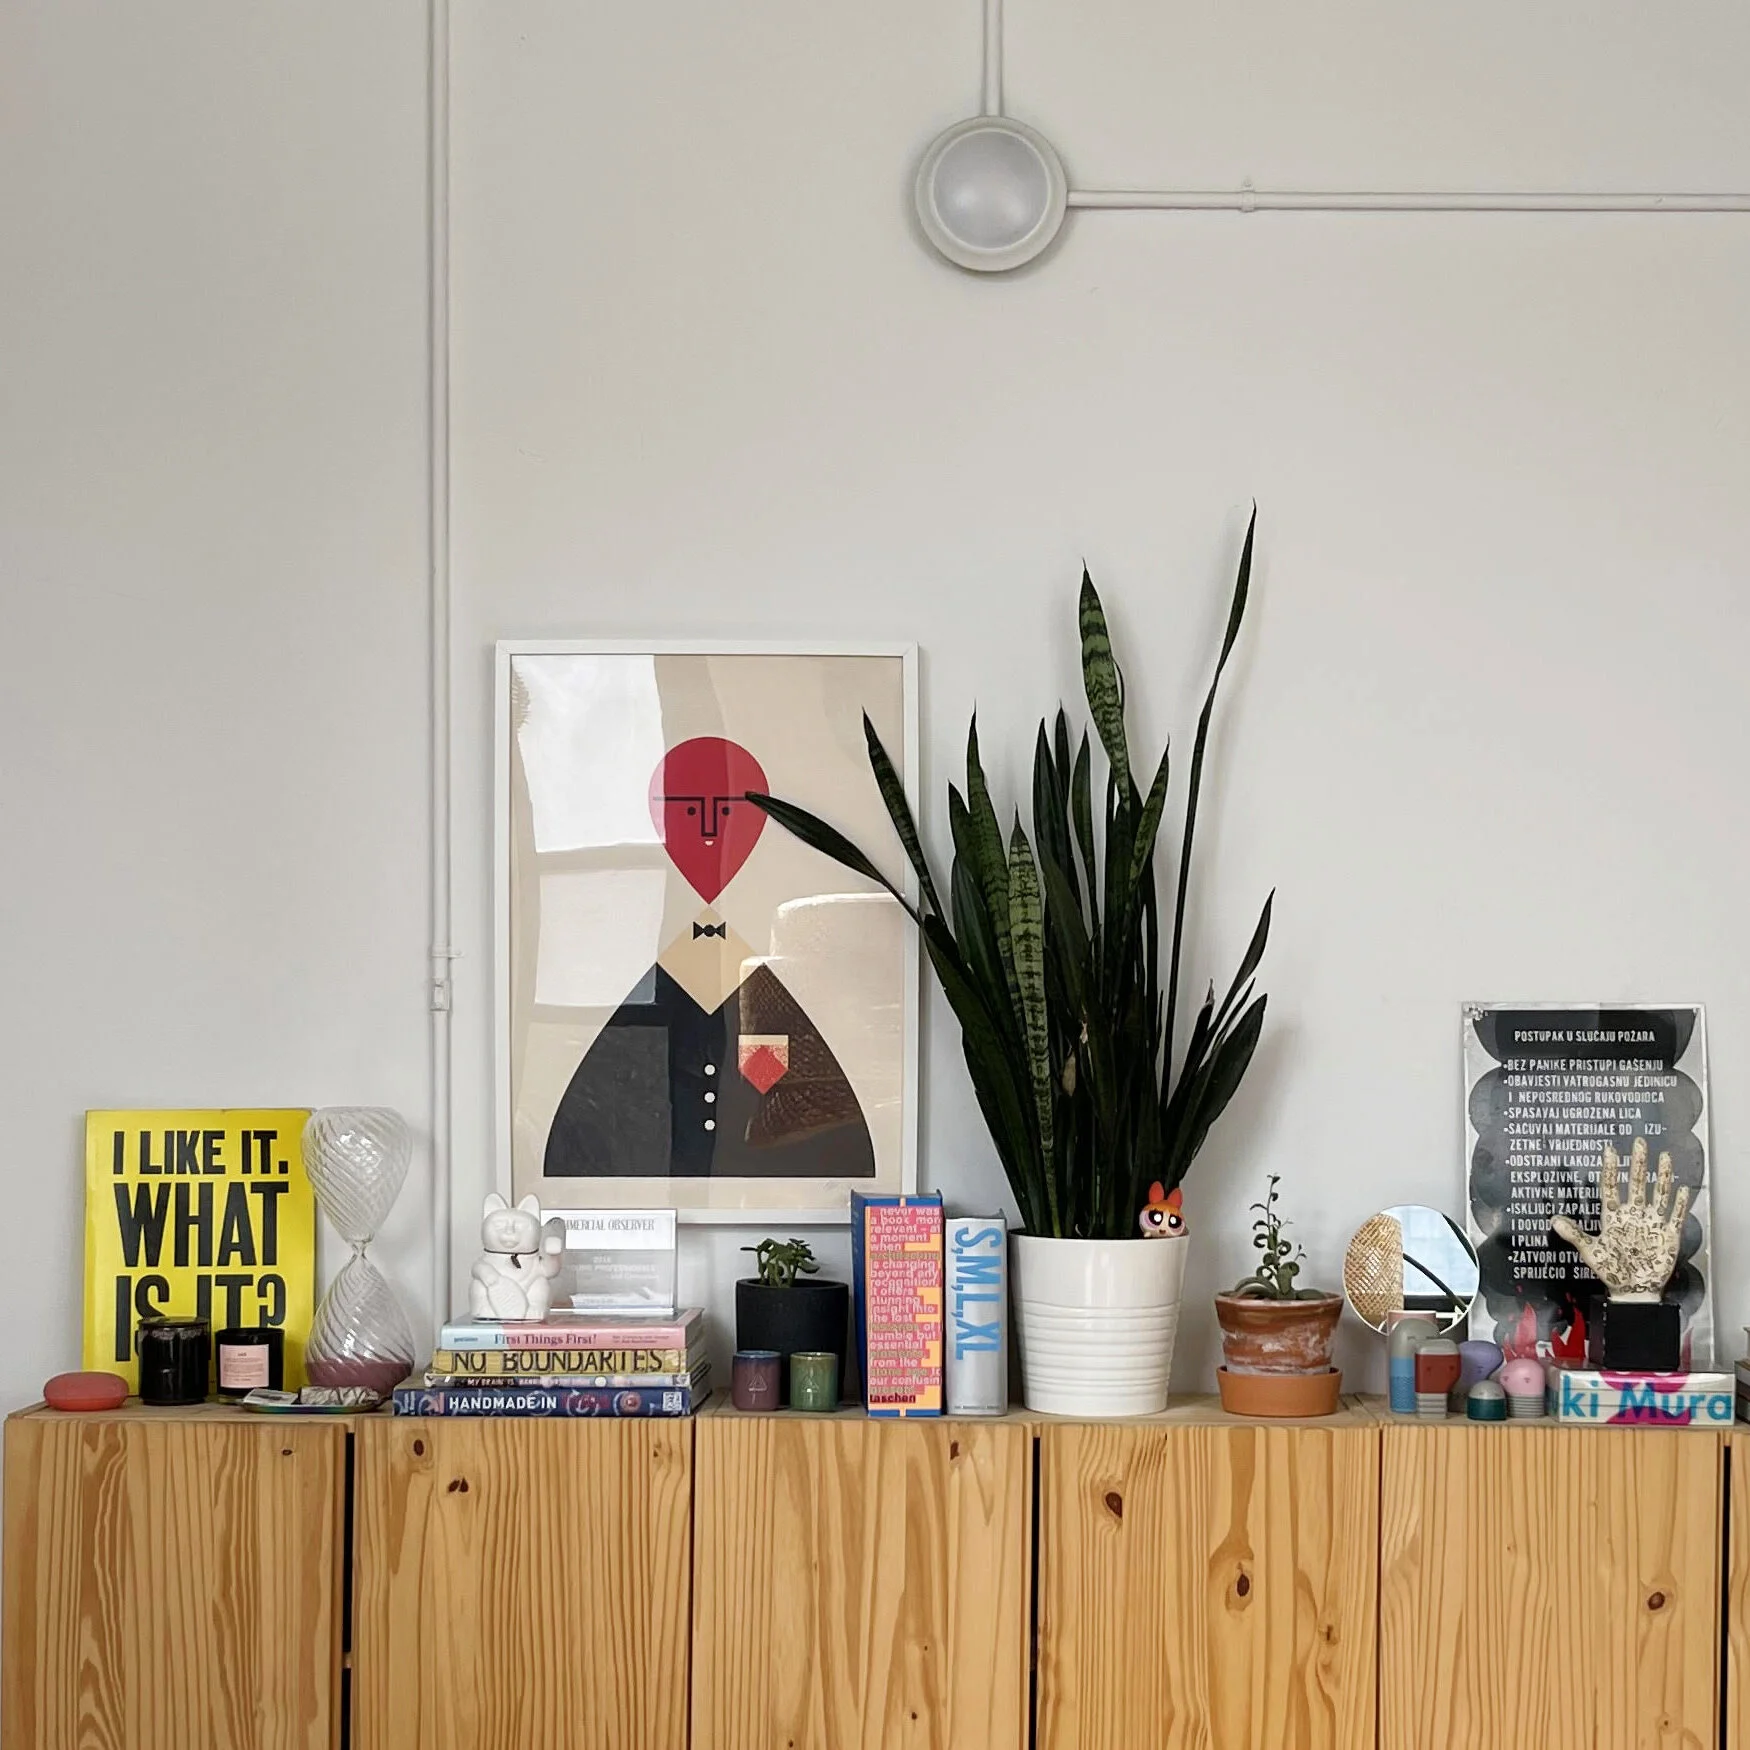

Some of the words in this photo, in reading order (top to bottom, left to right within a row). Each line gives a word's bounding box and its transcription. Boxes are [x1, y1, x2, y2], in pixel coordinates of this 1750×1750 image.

[1514, 1030, 1565, 1042] POSTUPAK
[1566, 1030, 1573, 1042] U
[1617, 1029, 1656, 1042] POŽARA
[1507, 1059, 1526, 1071] BEZ
[1529, 1059, 1566, 1071] PANIKE
[1569, 1059, 1617, 1071] PRISTUPI
[1619, 1058, 1664, 1071] GAŠENJU
[1507, 1075, 1561, 1087] OBAVJESTI
[1562, 1075, 1630, 1087] VATROGASNU
[1633, 1075, 1678, 1087] JEDINICU
[1508, 1091, 1513, 1103] I
[1518, 1091, 1592, 1103] NEPOSREDNOG
[1594, 1091, 1665, 1104] RUKOVODIOCA
[1508, 1107, 1560, 1119] SPASAVAJ
[1618, 1107, 1642, 1119] LICA
[1555, 1123, 1617, 1135] MATERIJALE
[1618, 1123, 1633, 1136] OD
[1644, 1123, 1668, 1135] IZU-
[113, 1131, 125, 1175] I
[139, 1130, 226, 1175] LIKE
[241, 1130, 289, 1175] IT.
[1509, 1154, 1561, 1167] ODSTRANI
[1511, 1187, 1554, 1199] AKTIVNE
[1557, 1187, 1602, 1199] MATERIJ
[880, 1207, 913, 1217] never
[915, 1207, 940, 1216] was
[1558, 1203, 1601, 1215] ZAPALJE
[113, 1181, 289, 1267] WHAT
[608, 1219, 655, 1231] OBSERVER
[881, 1214, 910, 1225] book
[1511, 1219, 1515, 1231] I
[870, 1224, 917, 1233] relevant
[880, 1233, 927, 1242] moment
[1511, 1235, 1516, 1247] I
[1518, 1235, 1549, 1247] PLINA
[870, 1241, 902, 1251] when
[1512, 1251, 1557, 1263] ZATVORI
[882, 1259, 936, 1272] changing
[870, 1268, 914, 1279] beyond
[1573, 1265, 1598, 1279] ŠIRE
[880, 1286, 914, 1296] offers
[870, 1296, 921, 1307] stunning
[494, 1334, 520, 1345] First
[524, 1333, 563, 1346] Things
[566, 1333, 597, 1345] First!
[916, 1331, 936, 1340] but
[870, 1340, 923, 1349] essential
[454, 1352, 487, 1372] NO
[502, 1351, 663, 1372] BOUNDARIES
[891, 1375, 941, 1386] confusin
[449, 1396, 539, 1410] HANDMADE
[541, 1396, 557, 1409] IN
[869, 1393, 916, 1403] taschen
[1562, 1374, 1600, 1418] ki
[1617, 1381, 1732, 1420] Mura
